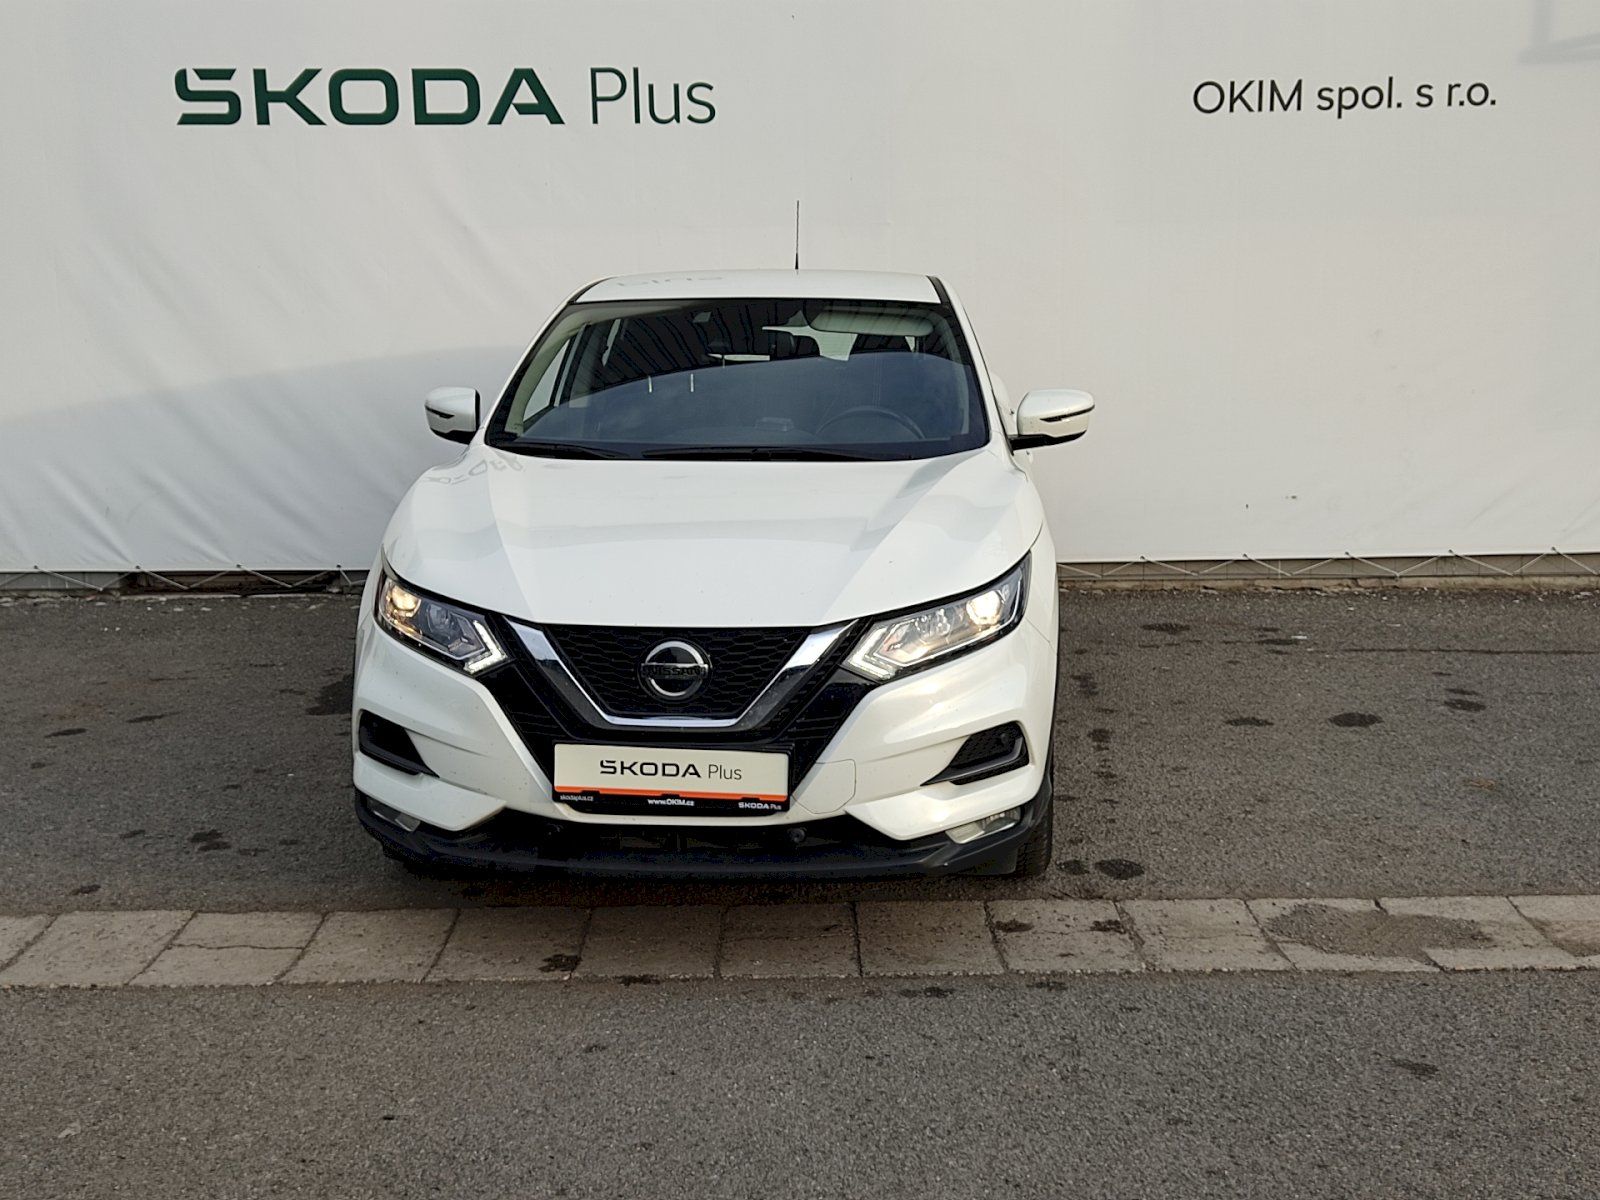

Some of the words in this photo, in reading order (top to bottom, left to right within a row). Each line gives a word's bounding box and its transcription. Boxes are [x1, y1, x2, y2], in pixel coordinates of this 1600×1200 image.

[589, 66, 716, 125] Plus
[1192, 79, 1303, 115] OKIM
[1316, 75, 1403, 119] spol.
[1415, 83, 1434, 108] s
[1446, 82, 1497, 107] r.o.
[708, 763, 743, 781] Plus
